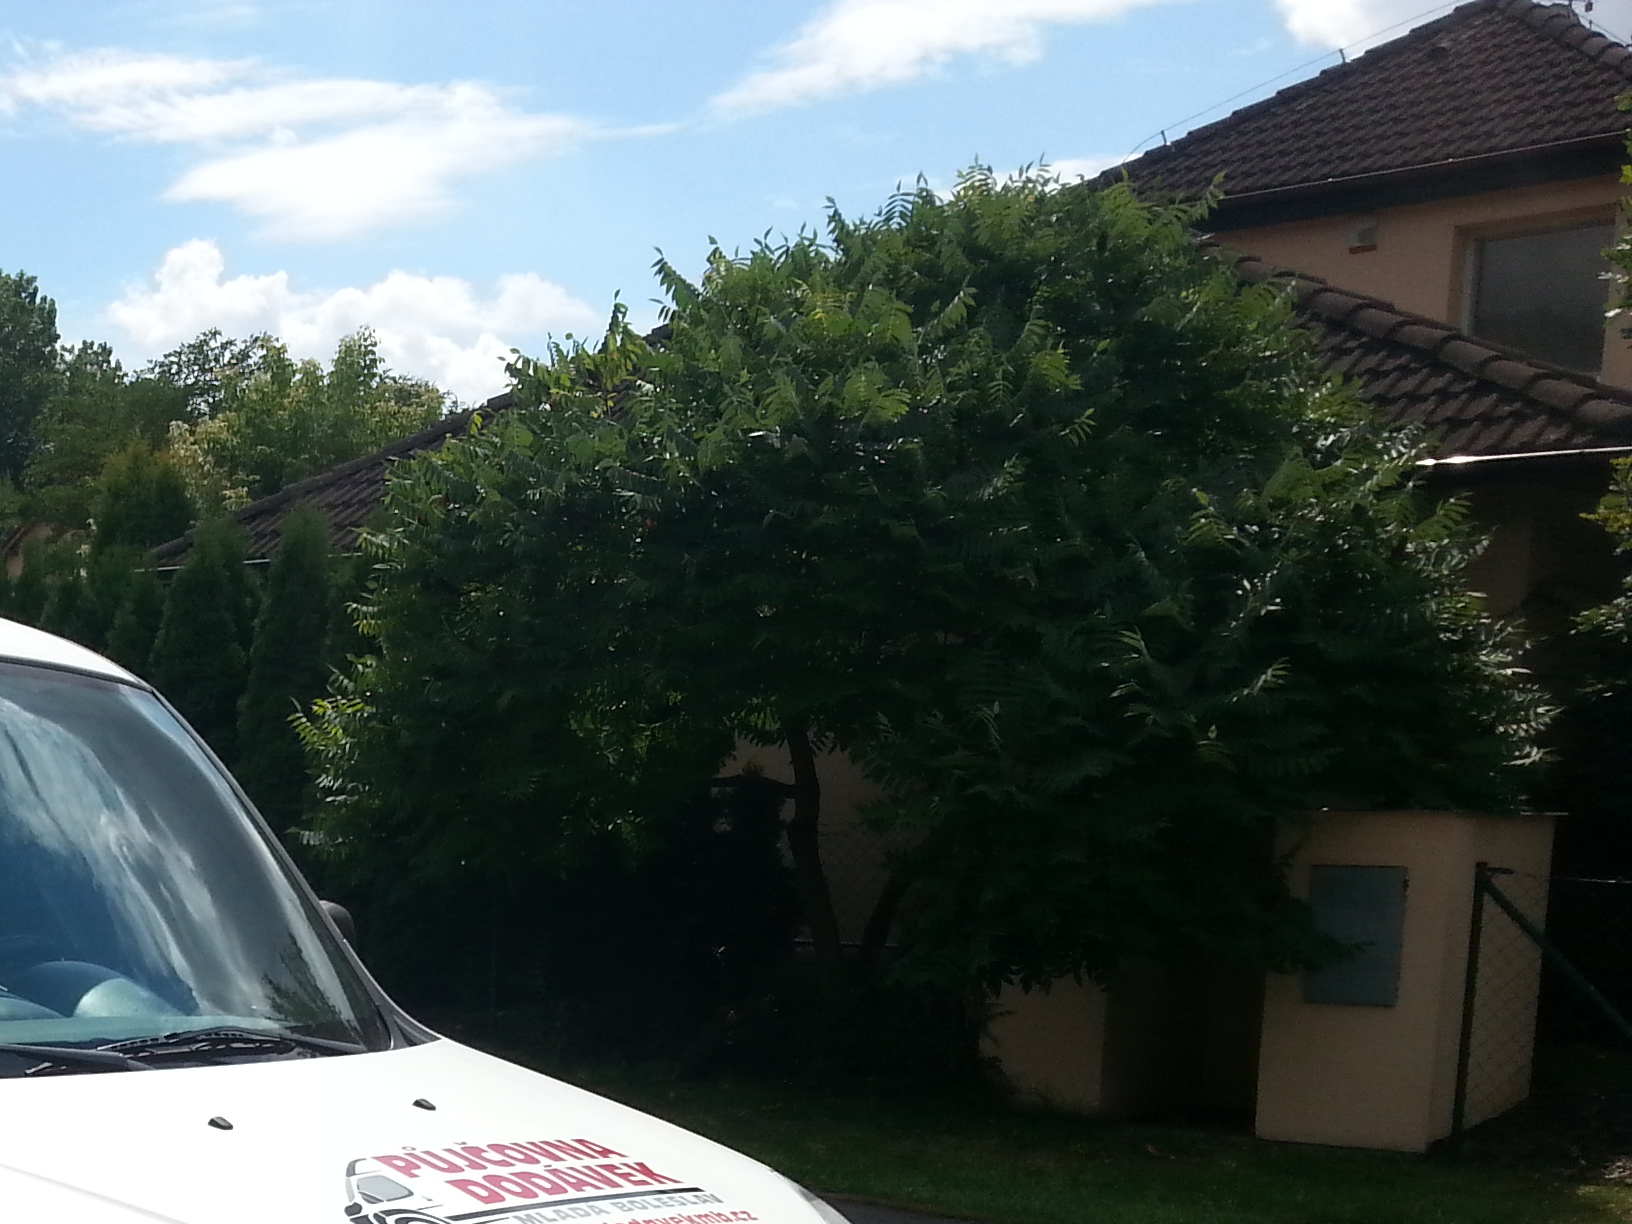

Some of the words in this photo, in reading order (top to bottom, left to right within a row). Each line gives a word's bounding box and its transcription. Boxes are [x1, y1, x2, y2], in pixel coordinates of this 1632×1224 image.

[371, 1138, 629, 1178] PŮJČOVNA
[444, 1161, 684, 1205] DODÁVEK
[611, 1193, 725, 1213] BOLESLAV
